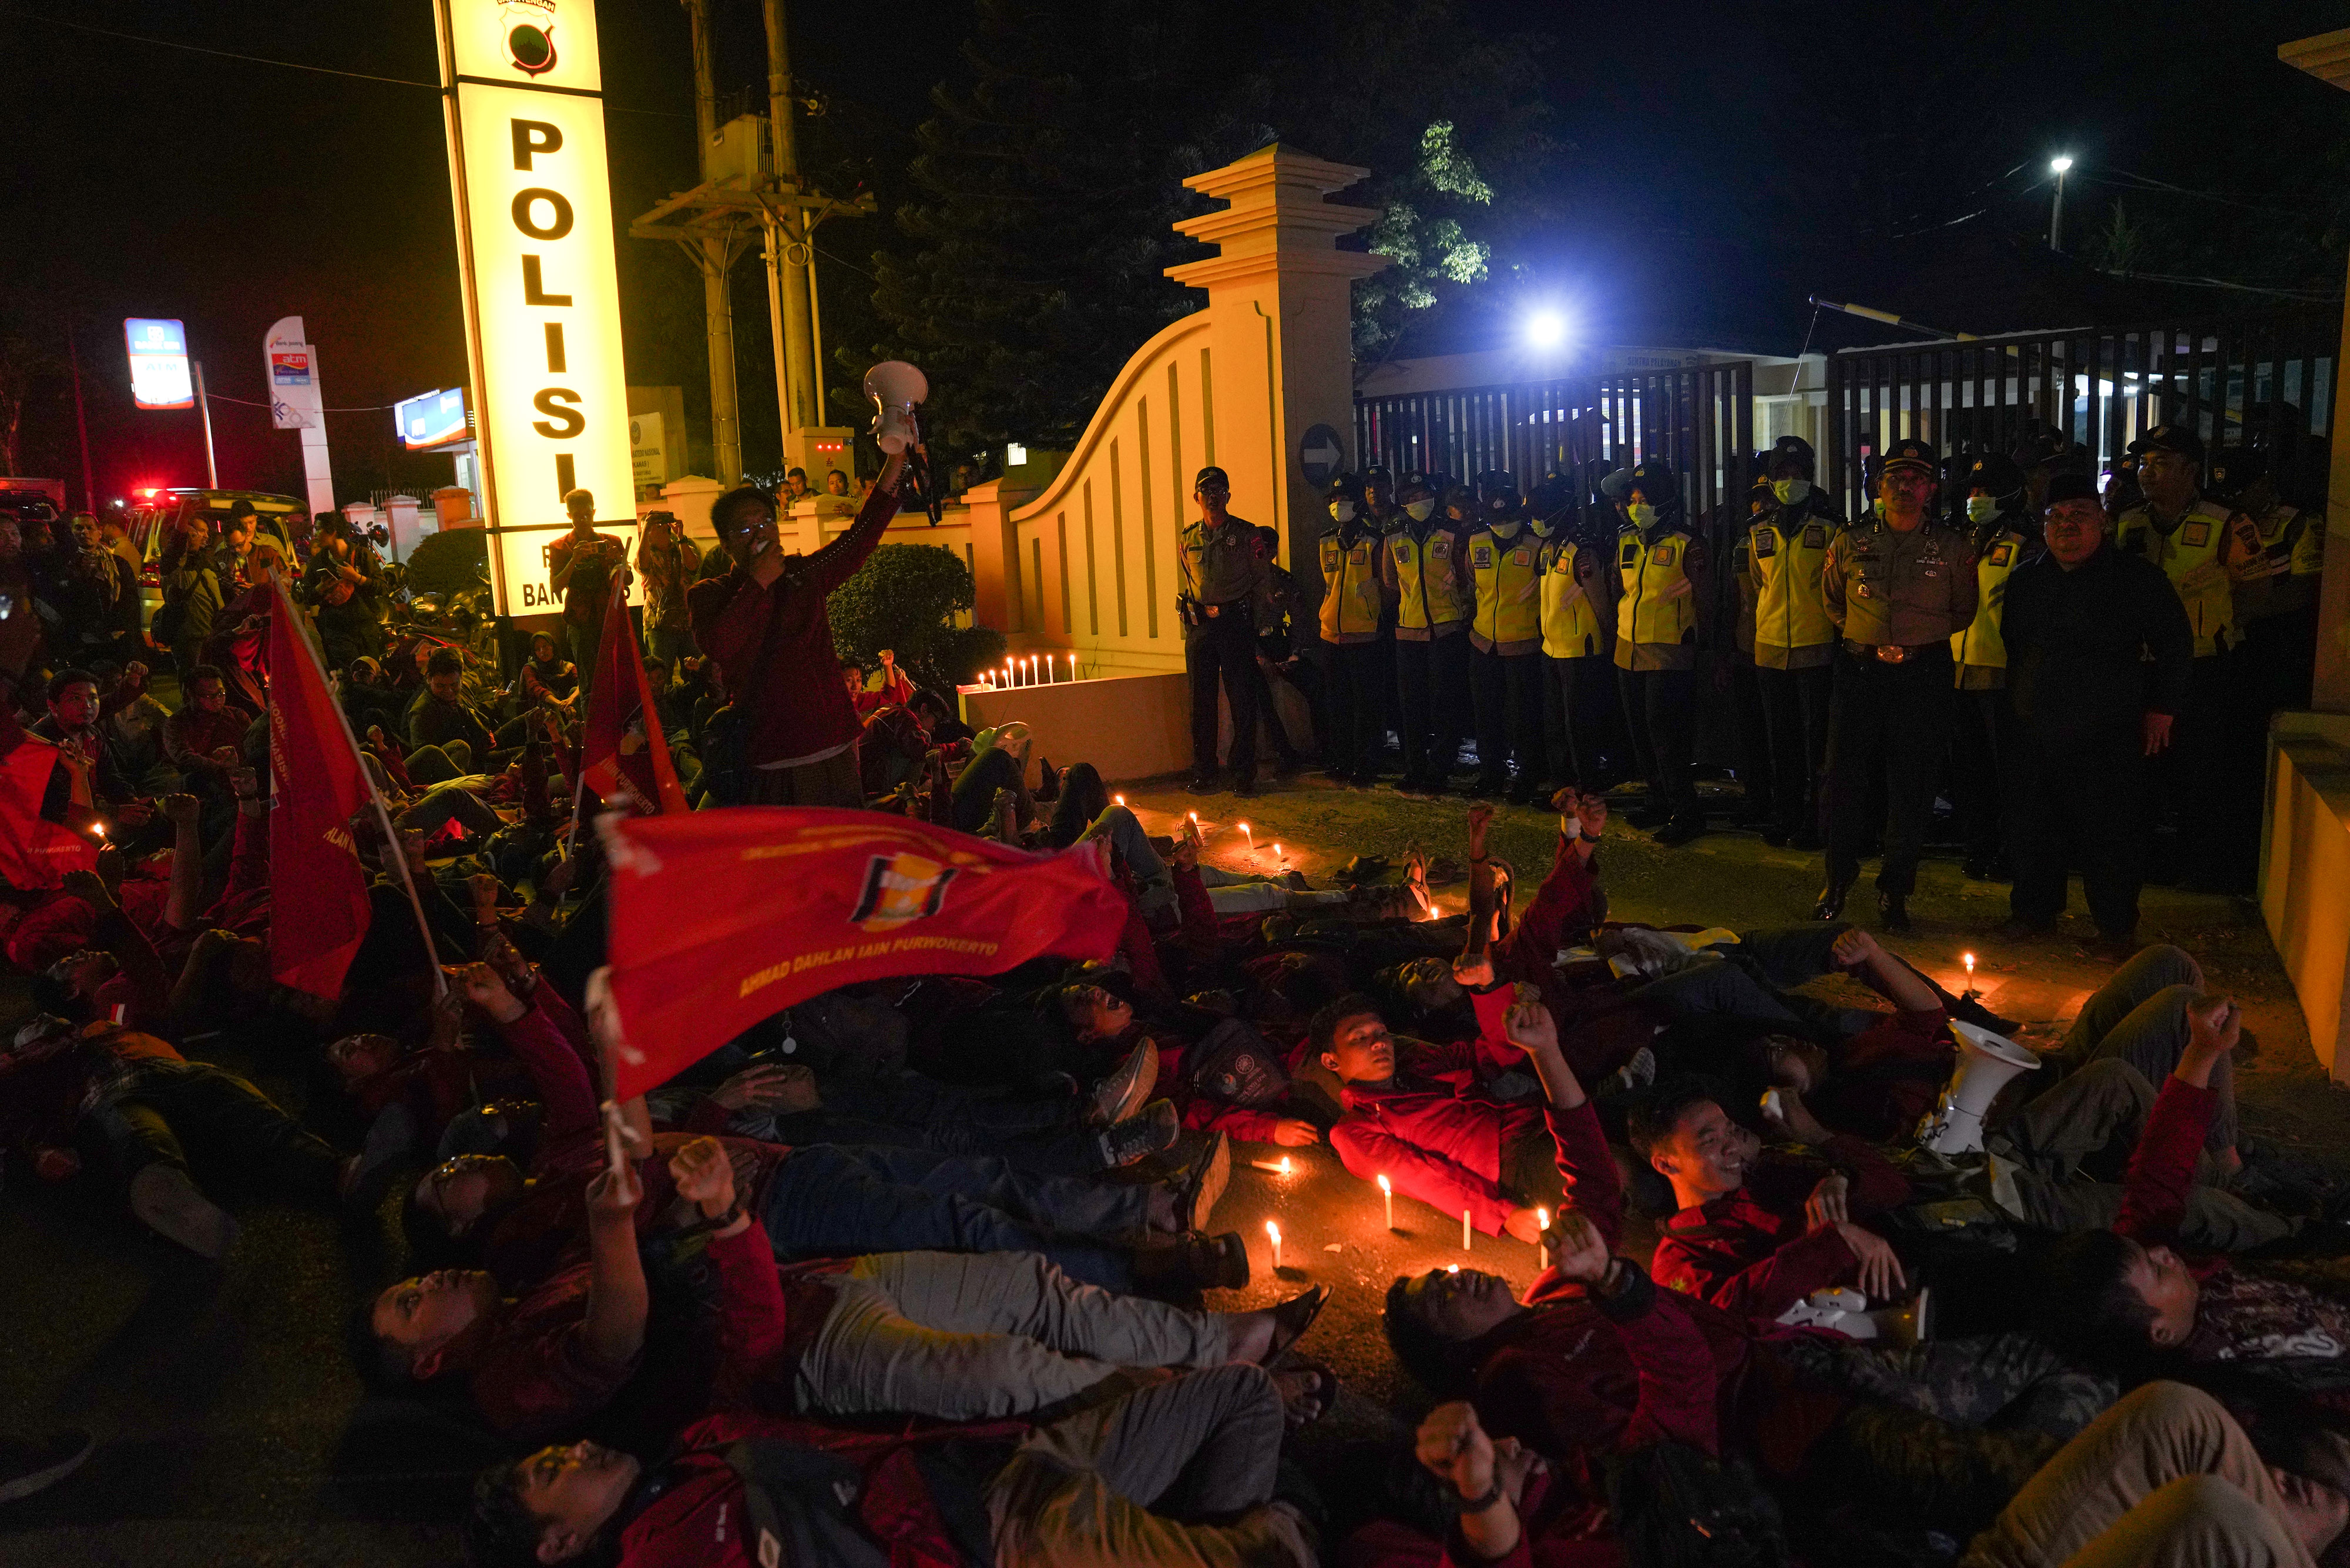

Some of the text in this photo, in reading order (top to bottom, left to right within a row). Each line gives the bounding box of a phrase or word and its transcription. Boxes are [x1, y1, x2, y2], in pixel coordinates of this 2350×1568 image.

[510, 117, 586, 504] POLISI
[146, 363, 177, 371] ATM
[283, 354, 307, 363] atm
[793, 945, 855, 973] DAHLAN
[857, 941, 892, 959] IAIN
[892, 935, 999, 956] PURWOKERTO
